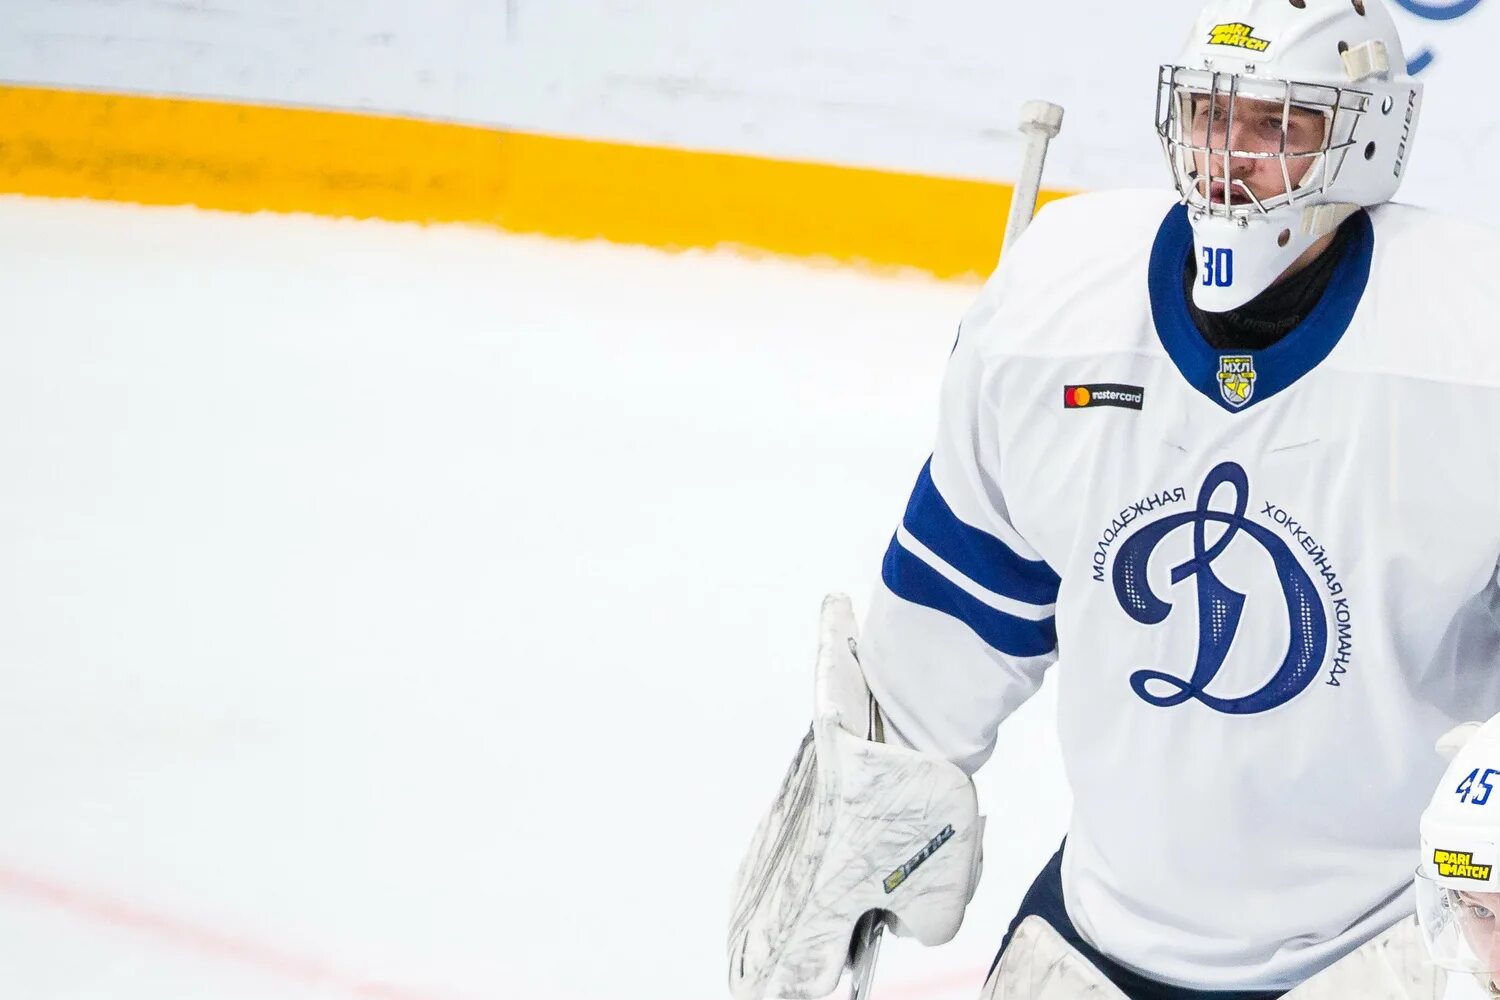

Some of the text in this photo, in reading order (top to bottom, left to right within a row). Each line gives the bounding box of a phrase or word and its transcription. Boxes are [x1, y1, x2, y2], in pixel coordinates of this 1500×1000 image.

[1393, 89, 1416, 178] BAUER
[1202, 246, 1233, 287] 30
[1223, 362, 1250, 373] МХЛ
[1091, 390, 1142, 403] mastercard
[1093, 486, 1186, 582] МОЛОДЕЖНАЯ
[1261, 500, 1352, 687] ХОККЕЙНАЯ КОМАНДА
[1434, 850, 1472, 866] PARI
[1438, 863, 1490, 880] MATCH
